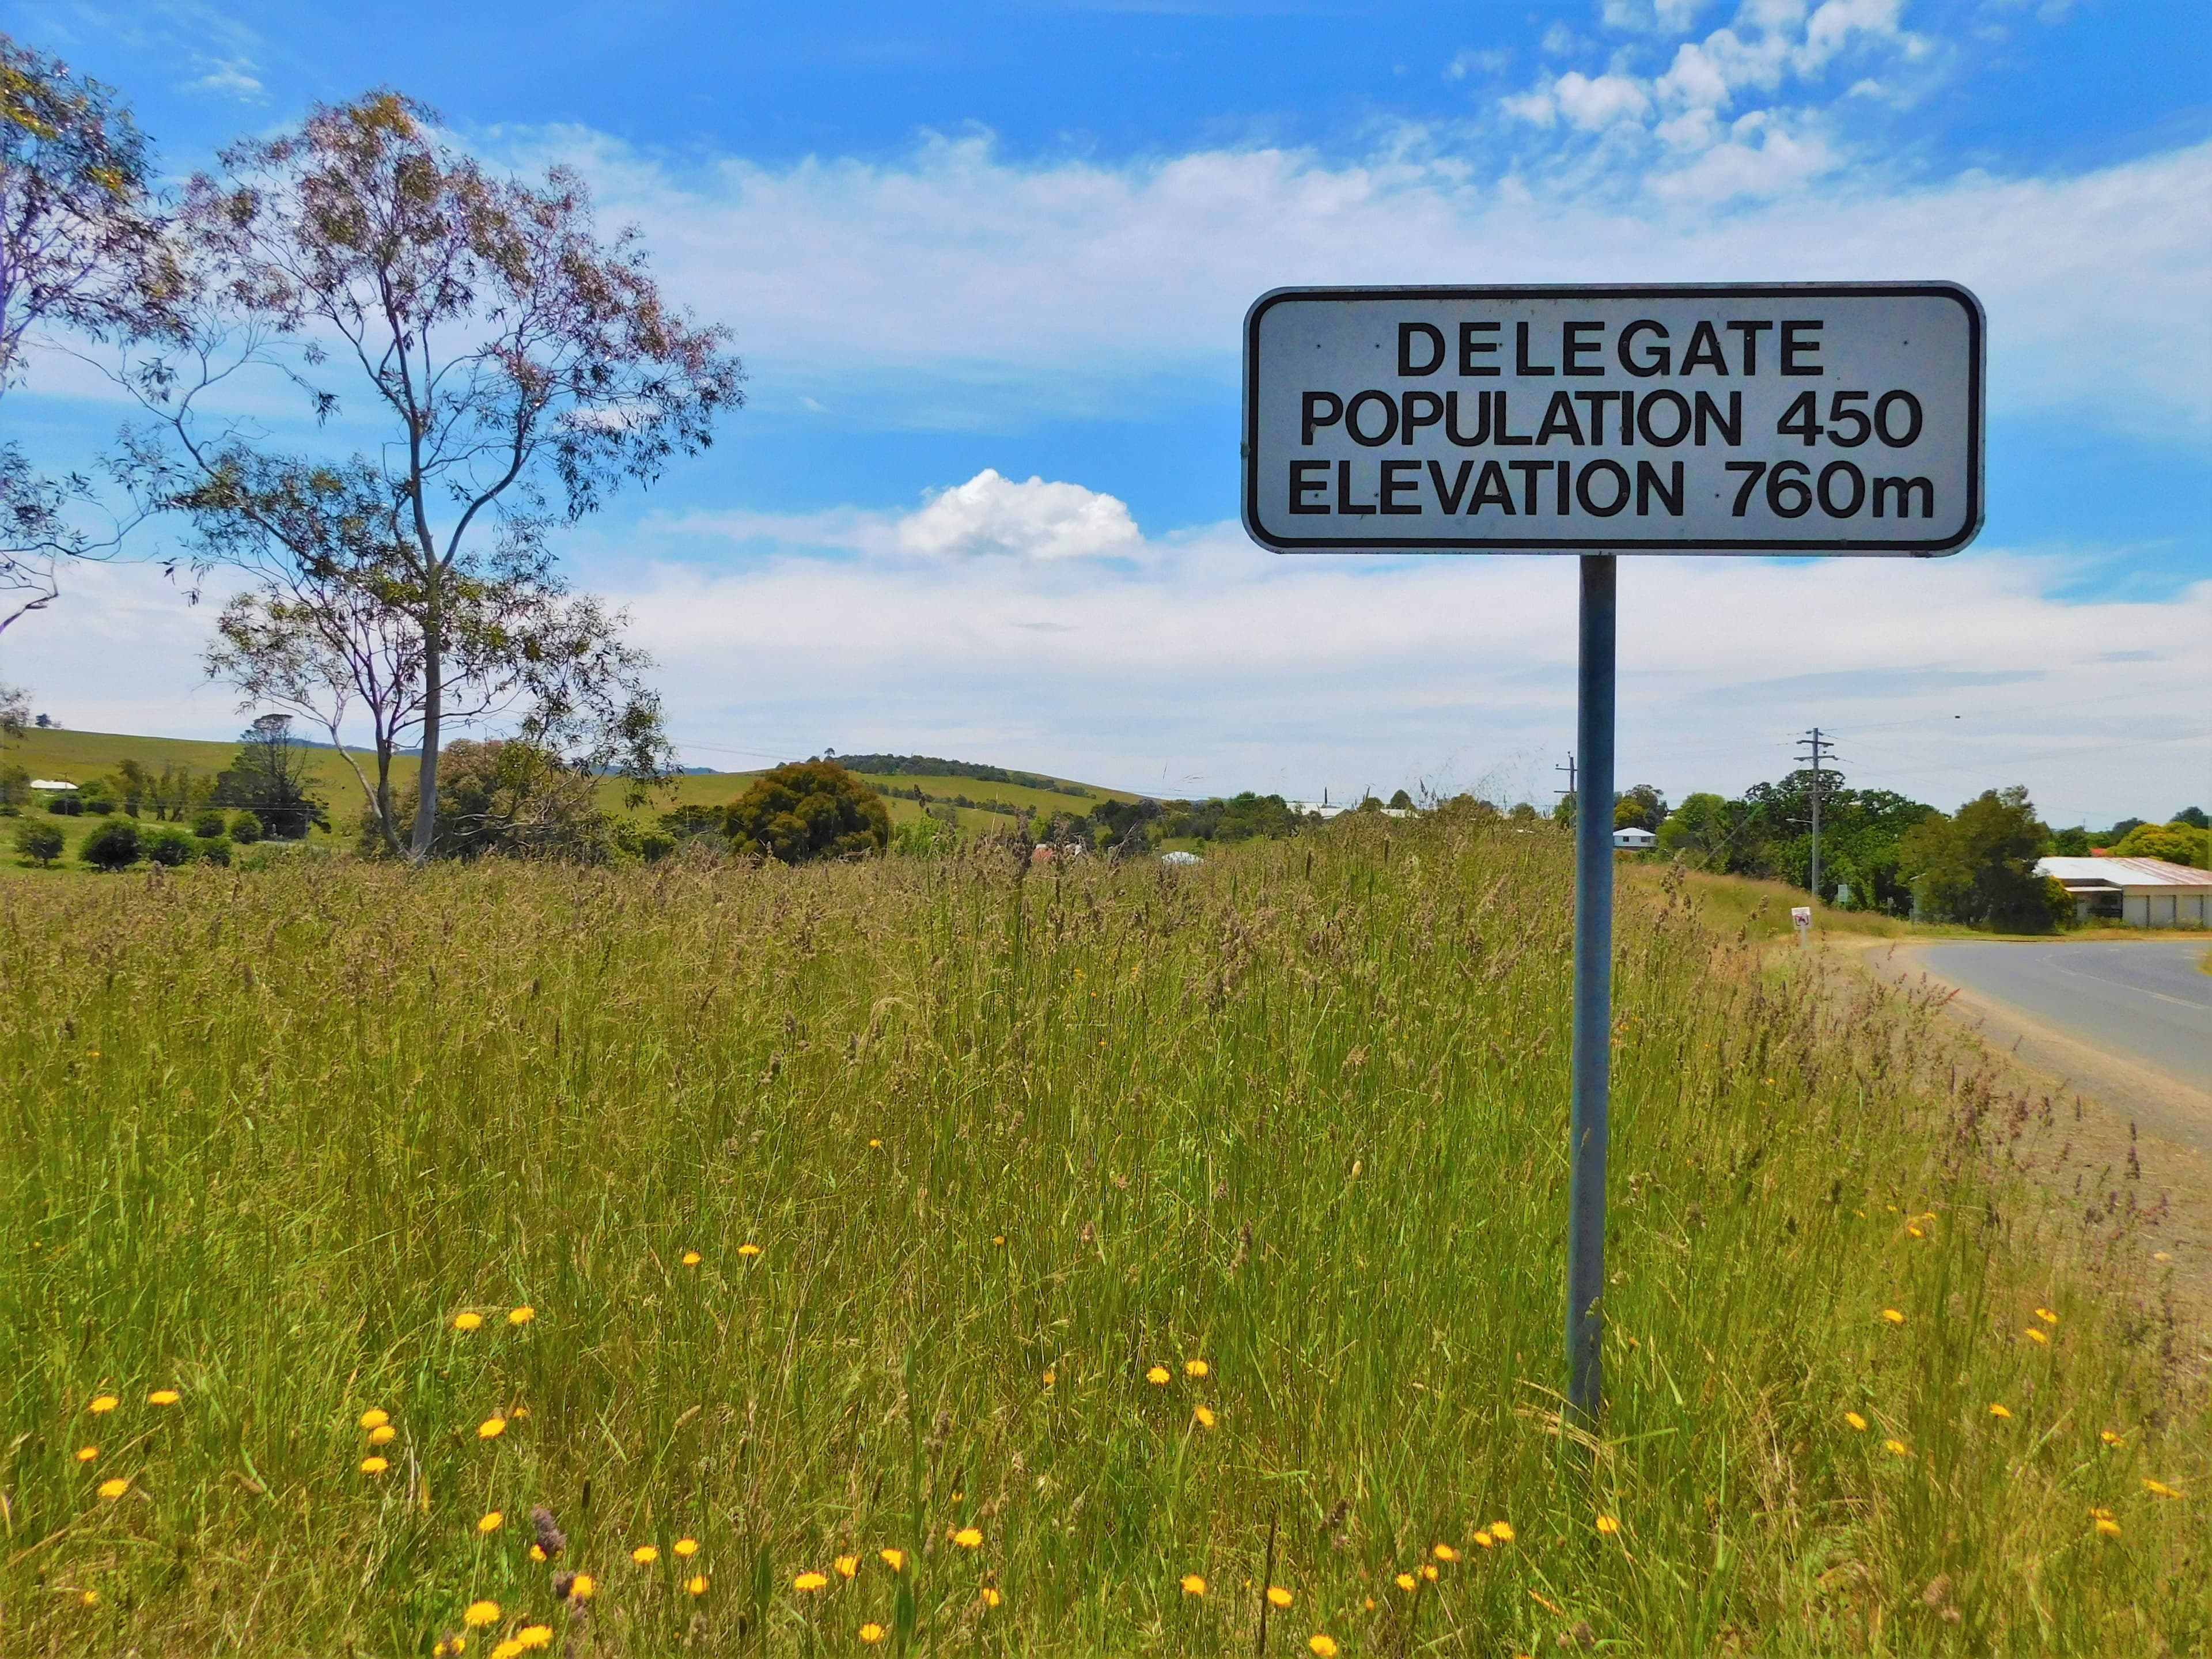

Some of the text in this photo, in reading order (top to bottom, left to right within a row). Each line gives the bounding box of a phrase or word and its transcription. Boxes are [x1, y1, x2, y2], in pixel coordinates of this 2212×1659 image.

[1397, 319, 1824, 377] DELEGATE
[1301, 389, 1923, 448] POPULATION 450
[1289, 459, 1934, 519] ELEVATION 760m
